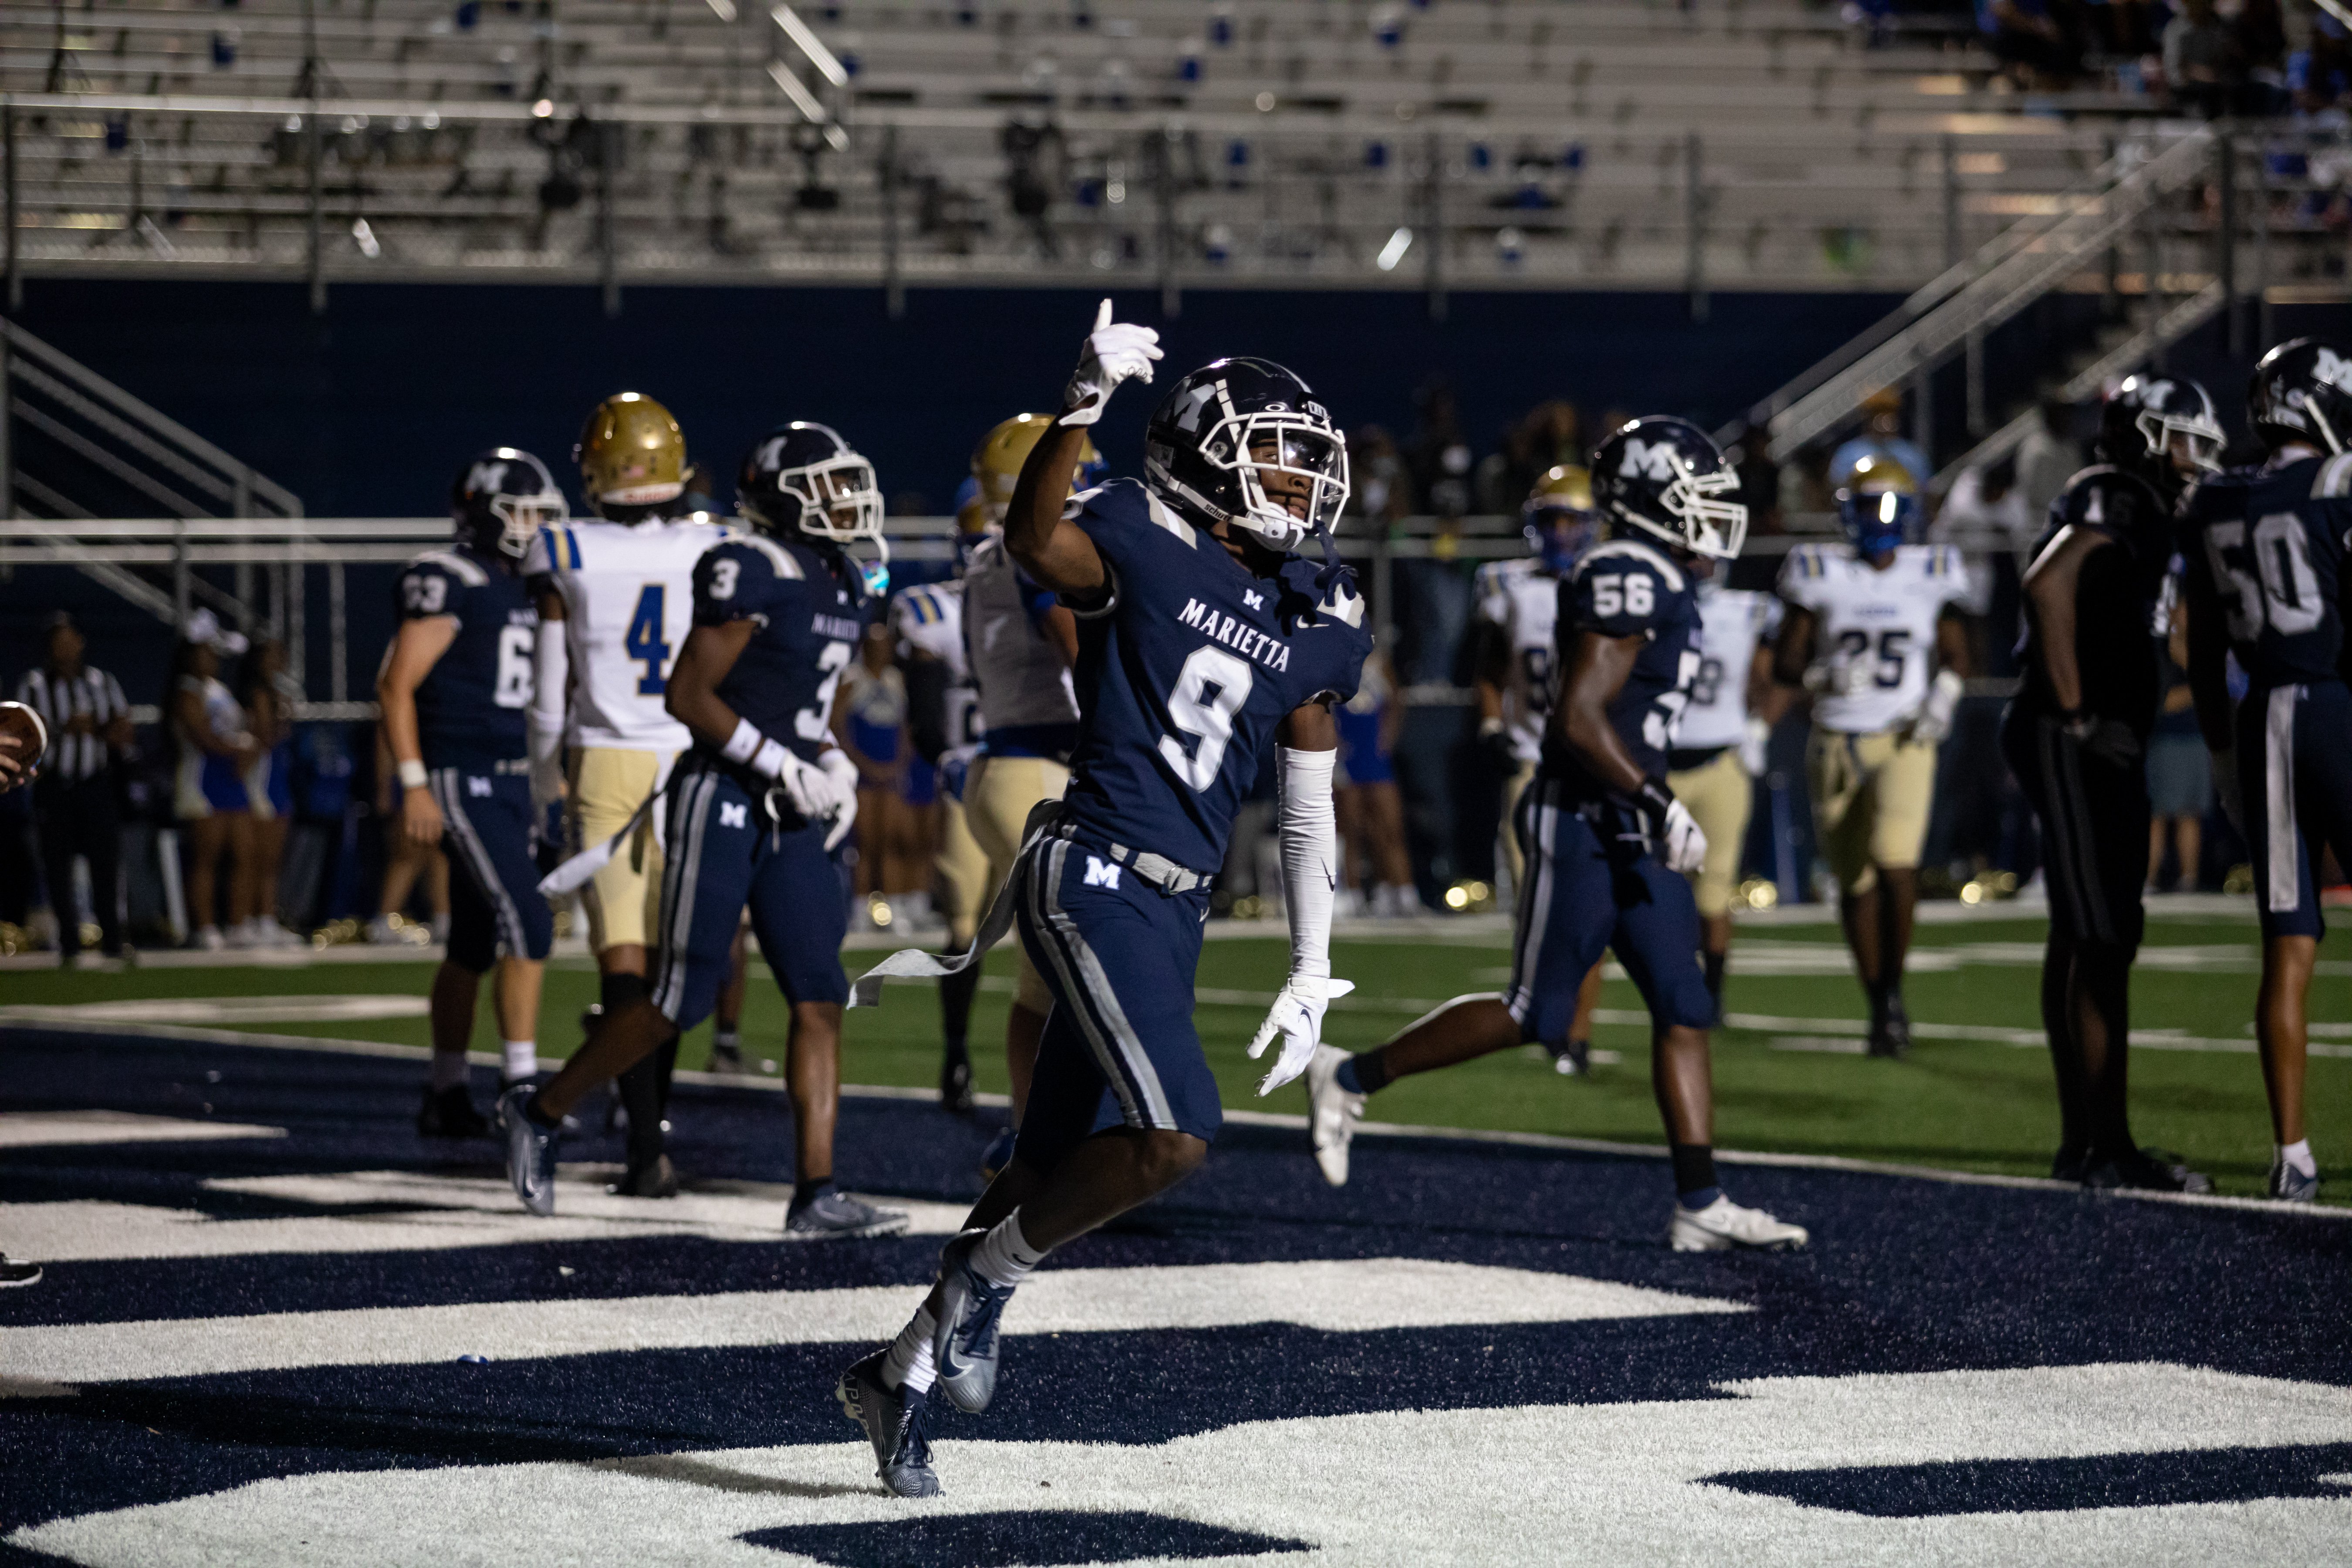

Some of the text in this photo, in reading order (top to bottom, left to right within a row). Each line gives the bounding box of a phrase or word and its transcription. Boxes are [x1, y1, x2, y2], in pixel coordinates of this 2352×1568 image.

[1153, 377, 1216, 432] M
[463, 462, 509, 493] M
[1619, 438, 1676, 482] M
[708, 558, 742, 601] 3
[1243, 588, 1264, 611] M
[1591, 572, 1655, 618] 56
[2202, 512, 2324, 642] 50
[625, 583, 670, 696] 4
[1177, 598, 1290, 672] MARIETTA
[794, 640, 852, 741] 3
[1157, 645, 1253, 794] 9
[719, 801, 748, 829] M
[1083, 855, 1121, 890] M
